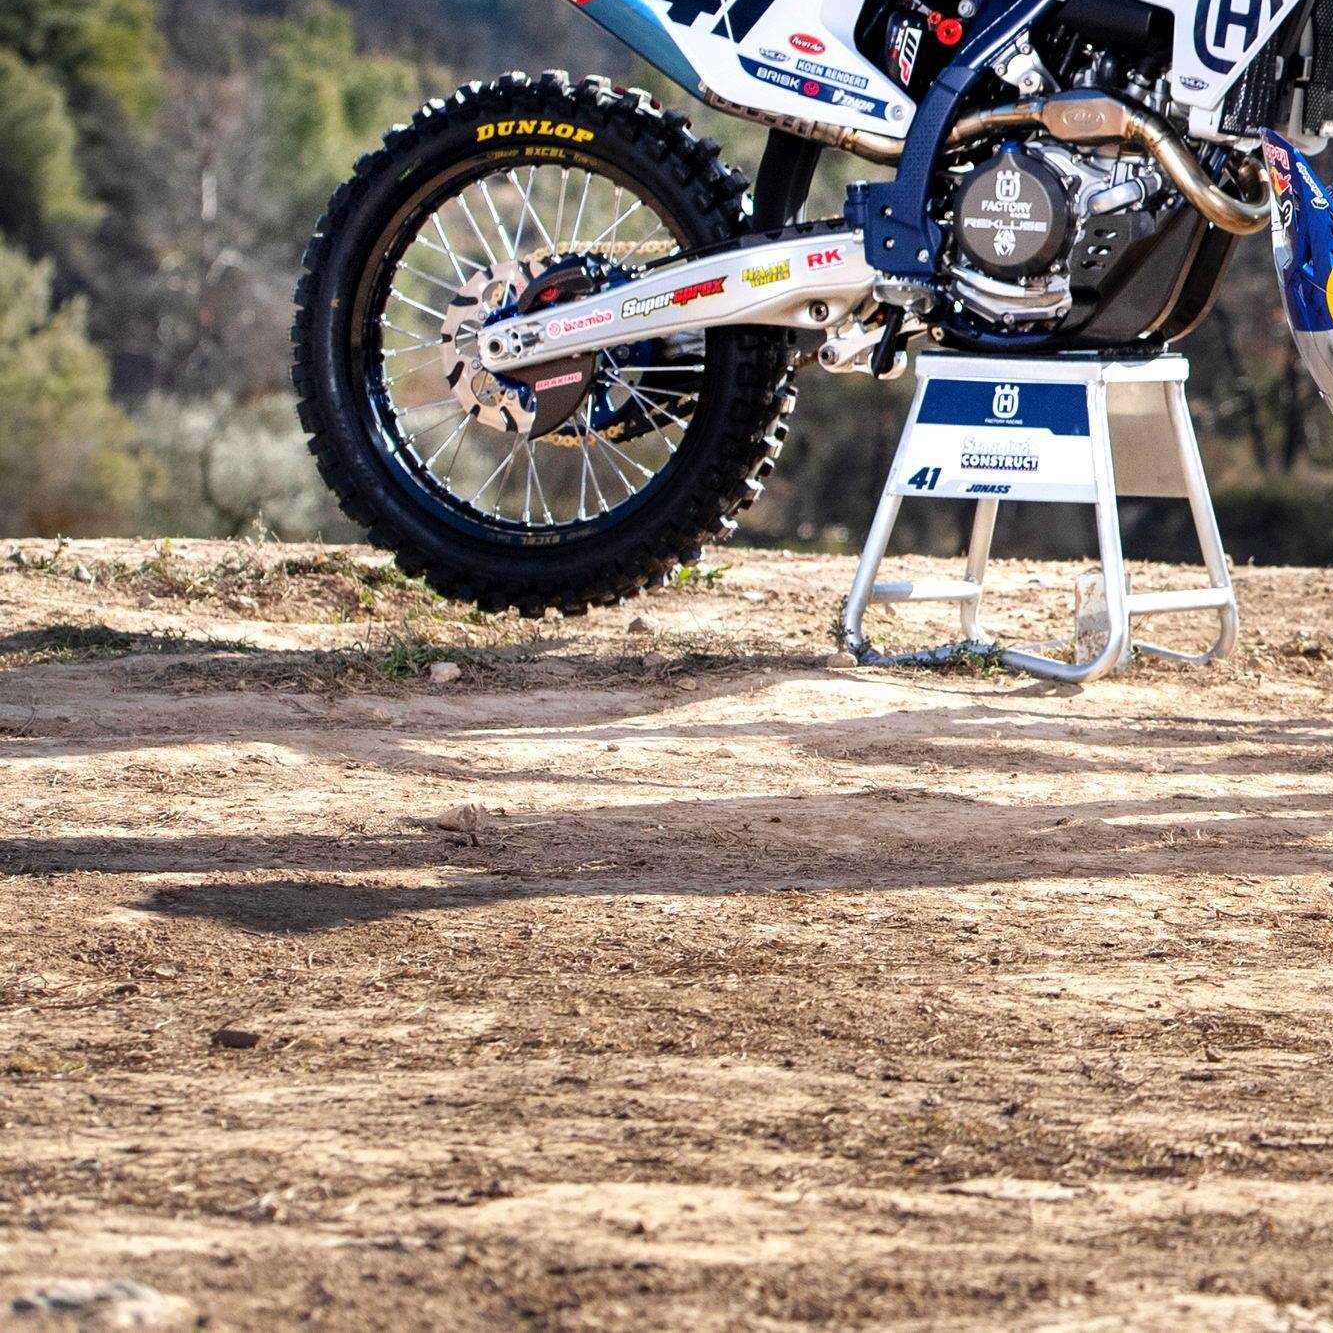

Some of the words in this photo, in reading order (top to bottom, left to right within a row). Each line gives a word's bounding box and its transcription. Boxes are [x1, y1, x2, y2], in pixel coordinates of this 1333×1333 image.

[798, 59, 824, 75] KOEN
[757, 67, 799, 89] BRISK
[476, 120, 594, 142] DUNLOP
[982, 201, 1032, 213] FACTORY
[807, 249, 842, 268] RK
[563, 311, 612, 333] brembo
[961, 453, 1038, 469] CONSTRUCT
[908, 467, 942, 491] 41
[966, 483, 1011, 494] JONASS
